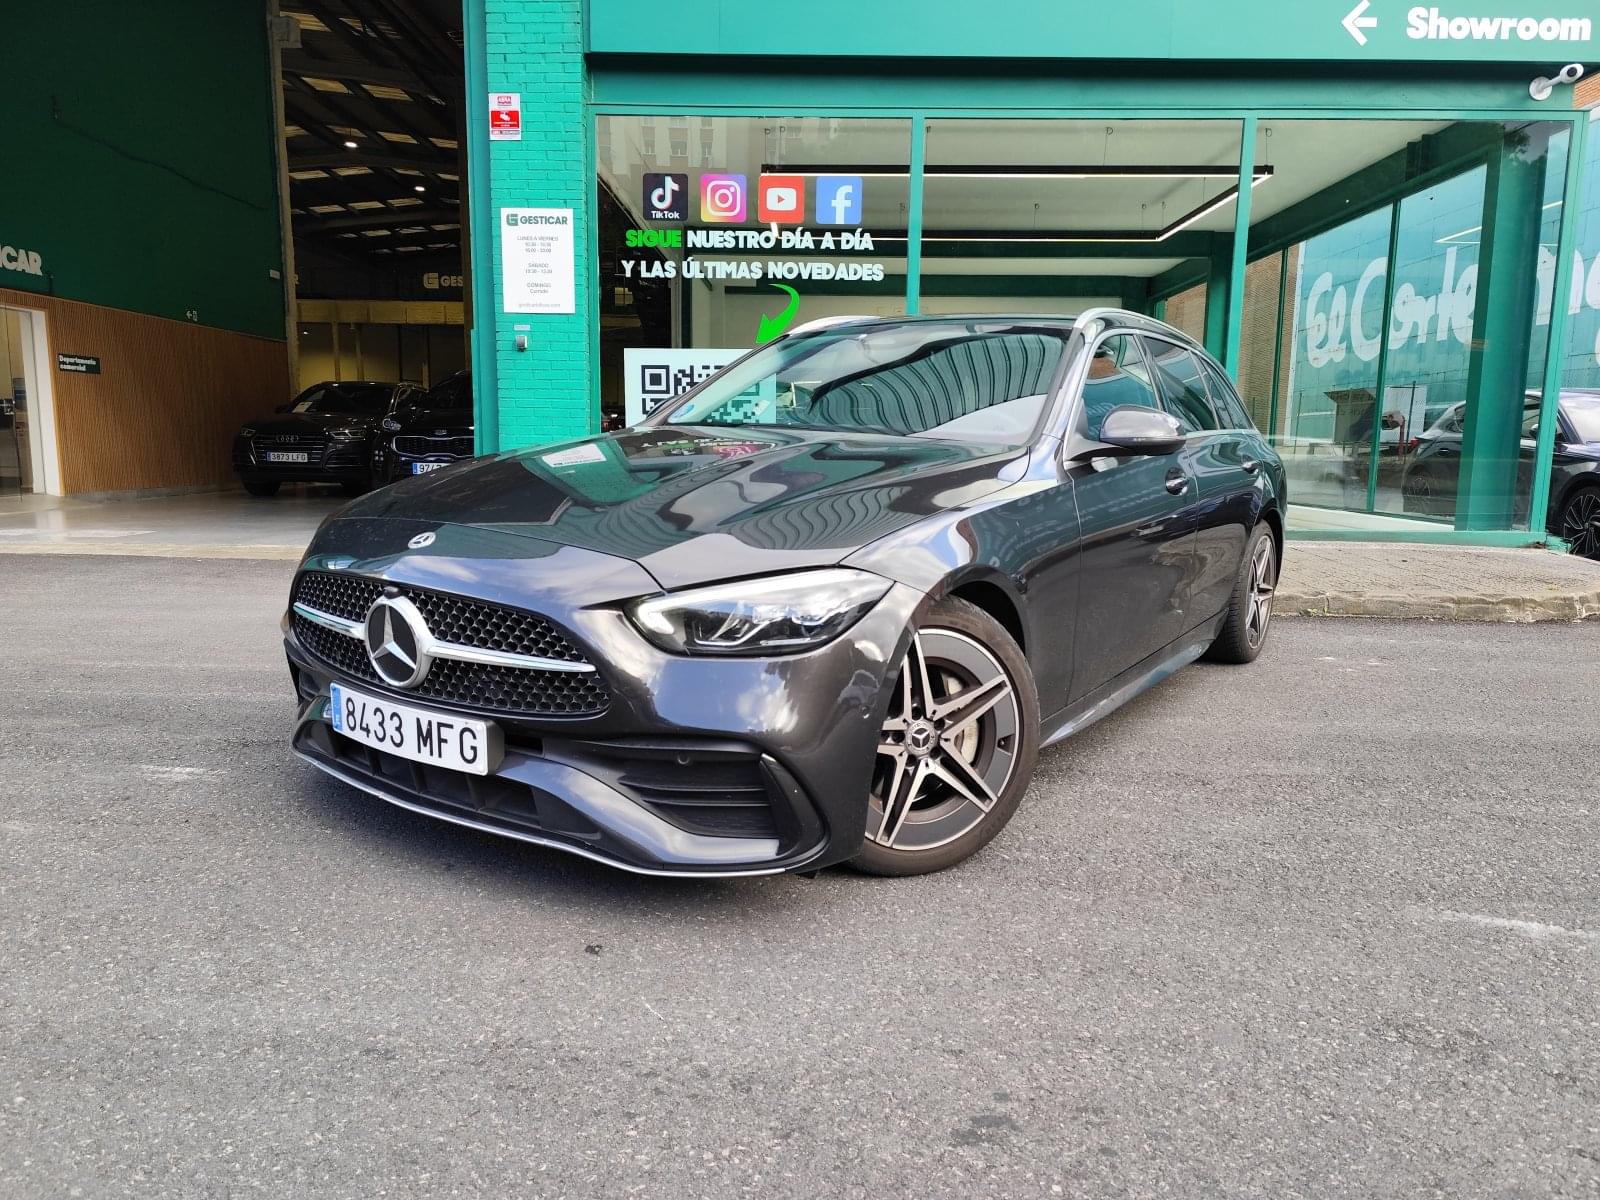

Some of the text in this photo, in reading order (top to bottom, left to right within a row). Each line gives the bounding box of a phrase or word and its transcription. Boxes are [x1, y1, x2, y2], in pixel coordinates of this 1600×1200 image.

[1406, 6, 1592, 41] Showroom
[520, 215, 568, 225] GESTICAR
[651, 210, 680, 219] TikTok
[625, 227, 874, 250] SIGUE NUESTRO DÍA A DÍA
[620, 256, 885, 281] Y LAS ÚLTIMAS NOVEDADES
[58, 354, 97, 366] Departamento
[346, 696, 478, 765] 8433 MFG
